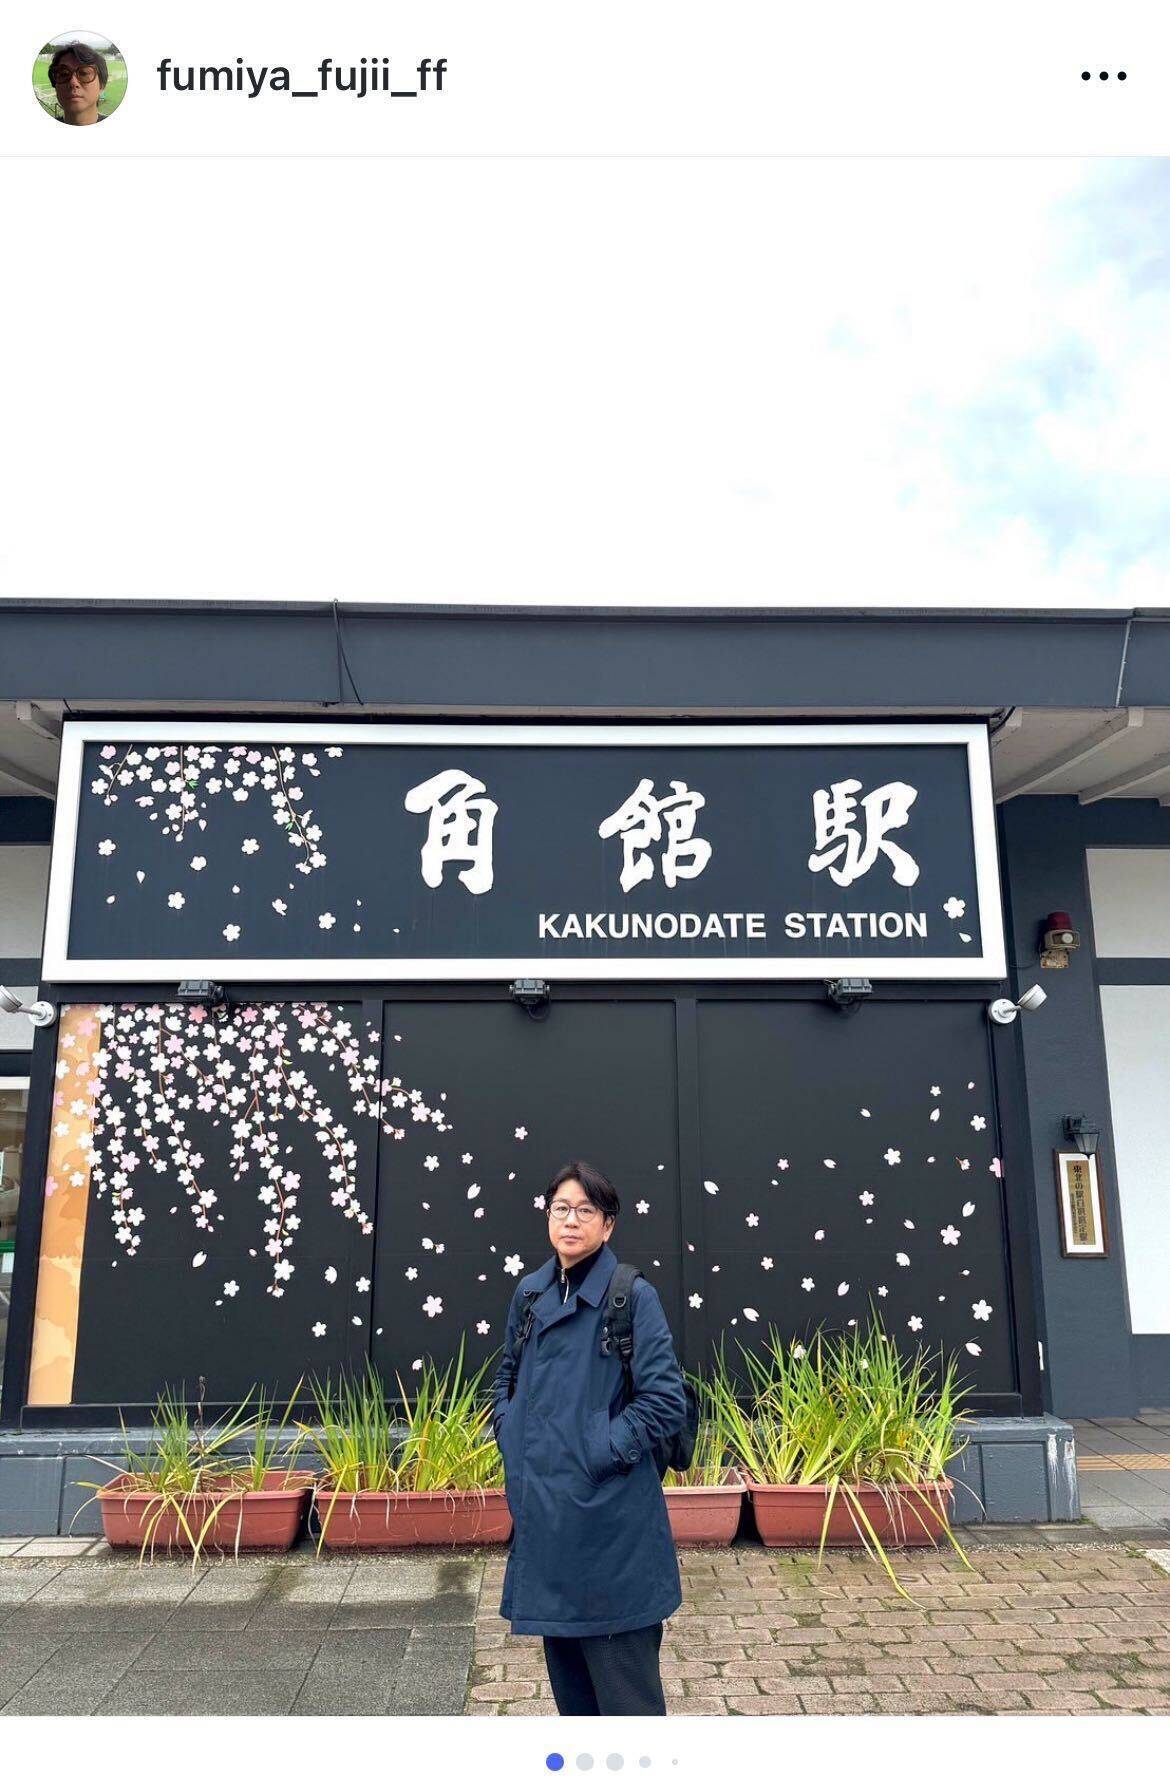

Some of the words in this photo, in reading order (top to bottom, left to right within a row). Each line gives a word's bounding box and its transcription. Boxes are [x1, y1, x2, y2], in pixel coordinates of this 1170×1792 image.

[405, 769, 919, 894] 角館駅
[539, 913, 766, 938] KAKUNODATE
[785, 911, 928, 937] STATION
